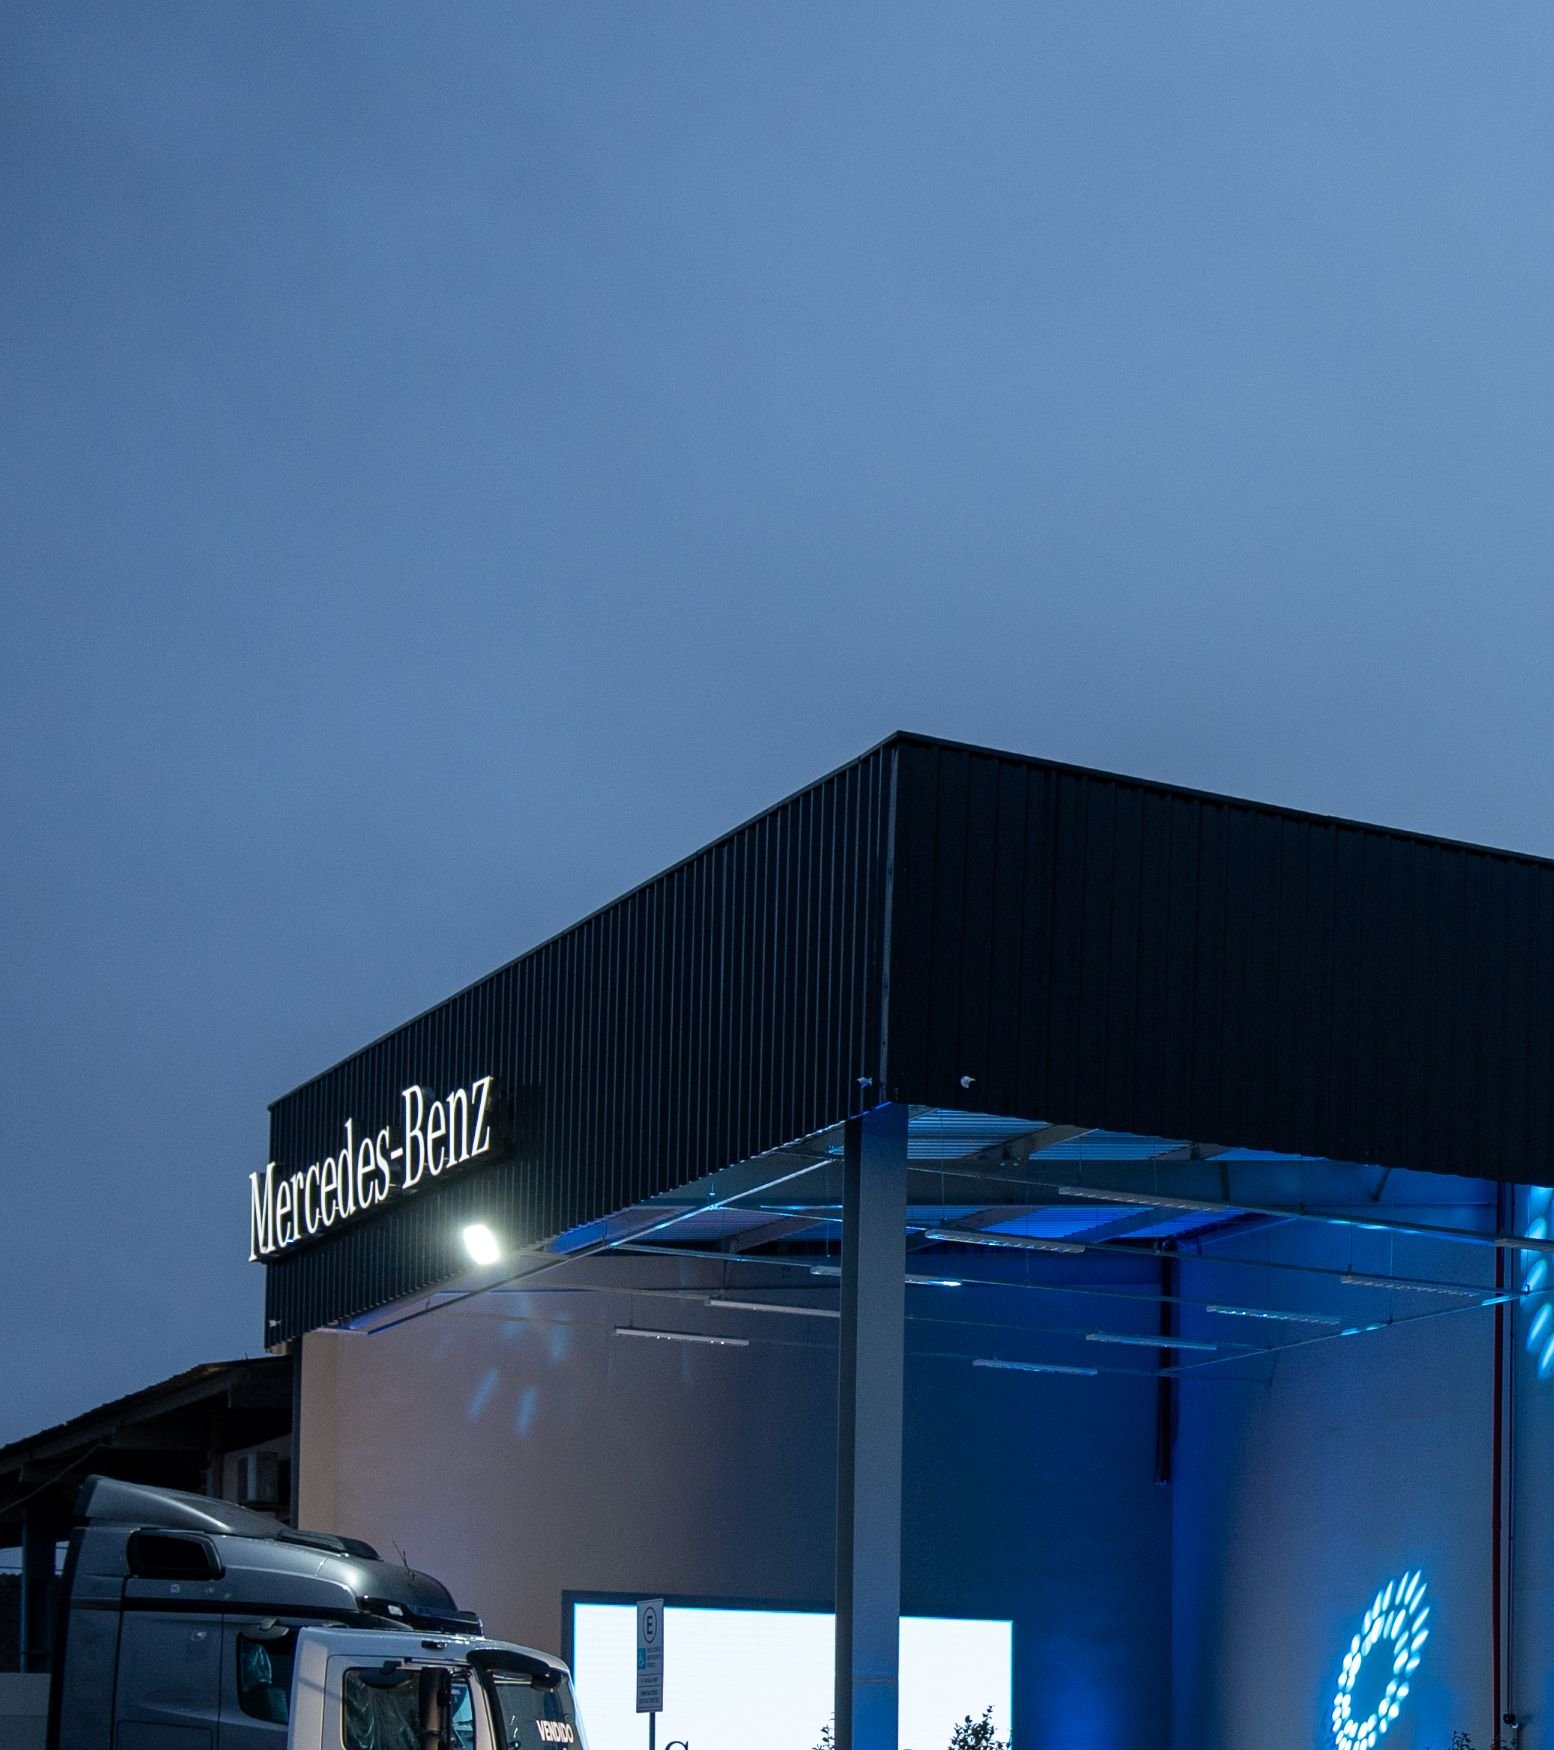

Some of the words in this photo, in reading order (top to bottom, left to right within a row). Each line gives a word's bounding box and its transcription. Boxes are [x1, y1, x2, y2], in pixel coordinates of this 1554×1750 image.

[248, 1075, 494, 1262] Mercedes-Benz
[646, 1615, 654, 1635] E
[536, 1719, 574, 1743] VENDIDO
